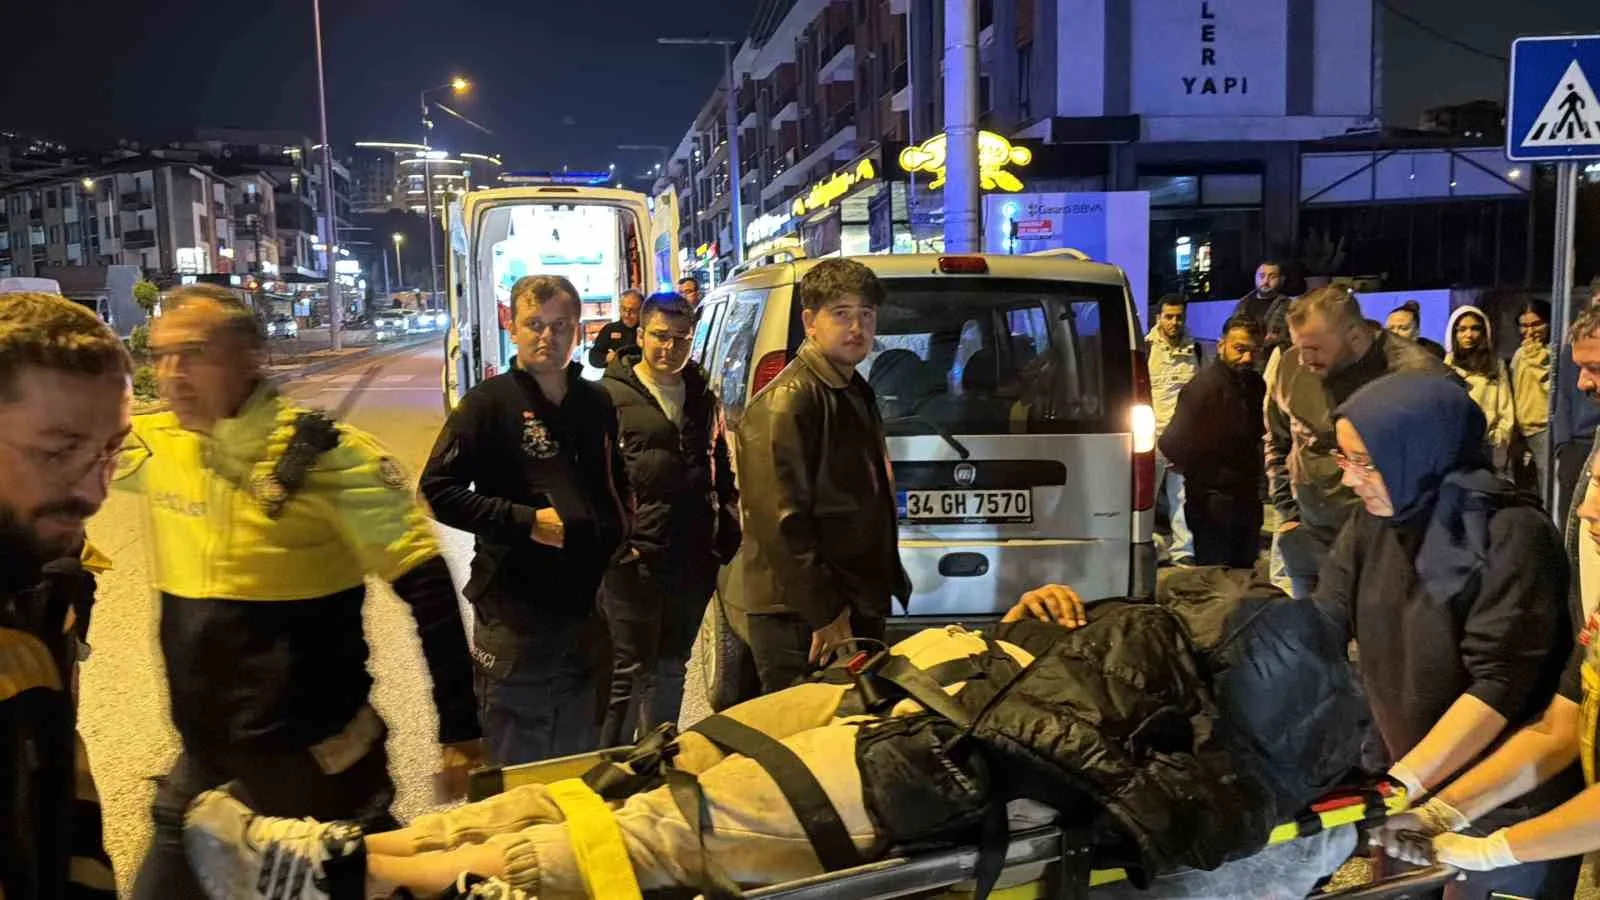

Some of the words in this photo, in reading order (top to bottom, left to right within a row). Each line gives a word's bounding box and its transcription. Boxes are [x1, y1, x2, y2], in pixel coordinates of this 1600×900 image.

[1181, 76, 1248, 95] YAPI
[908, 493, 934, 516] 34
[941, 493, 968, 516] GH
[974, 492, 1027, 515] 7570
